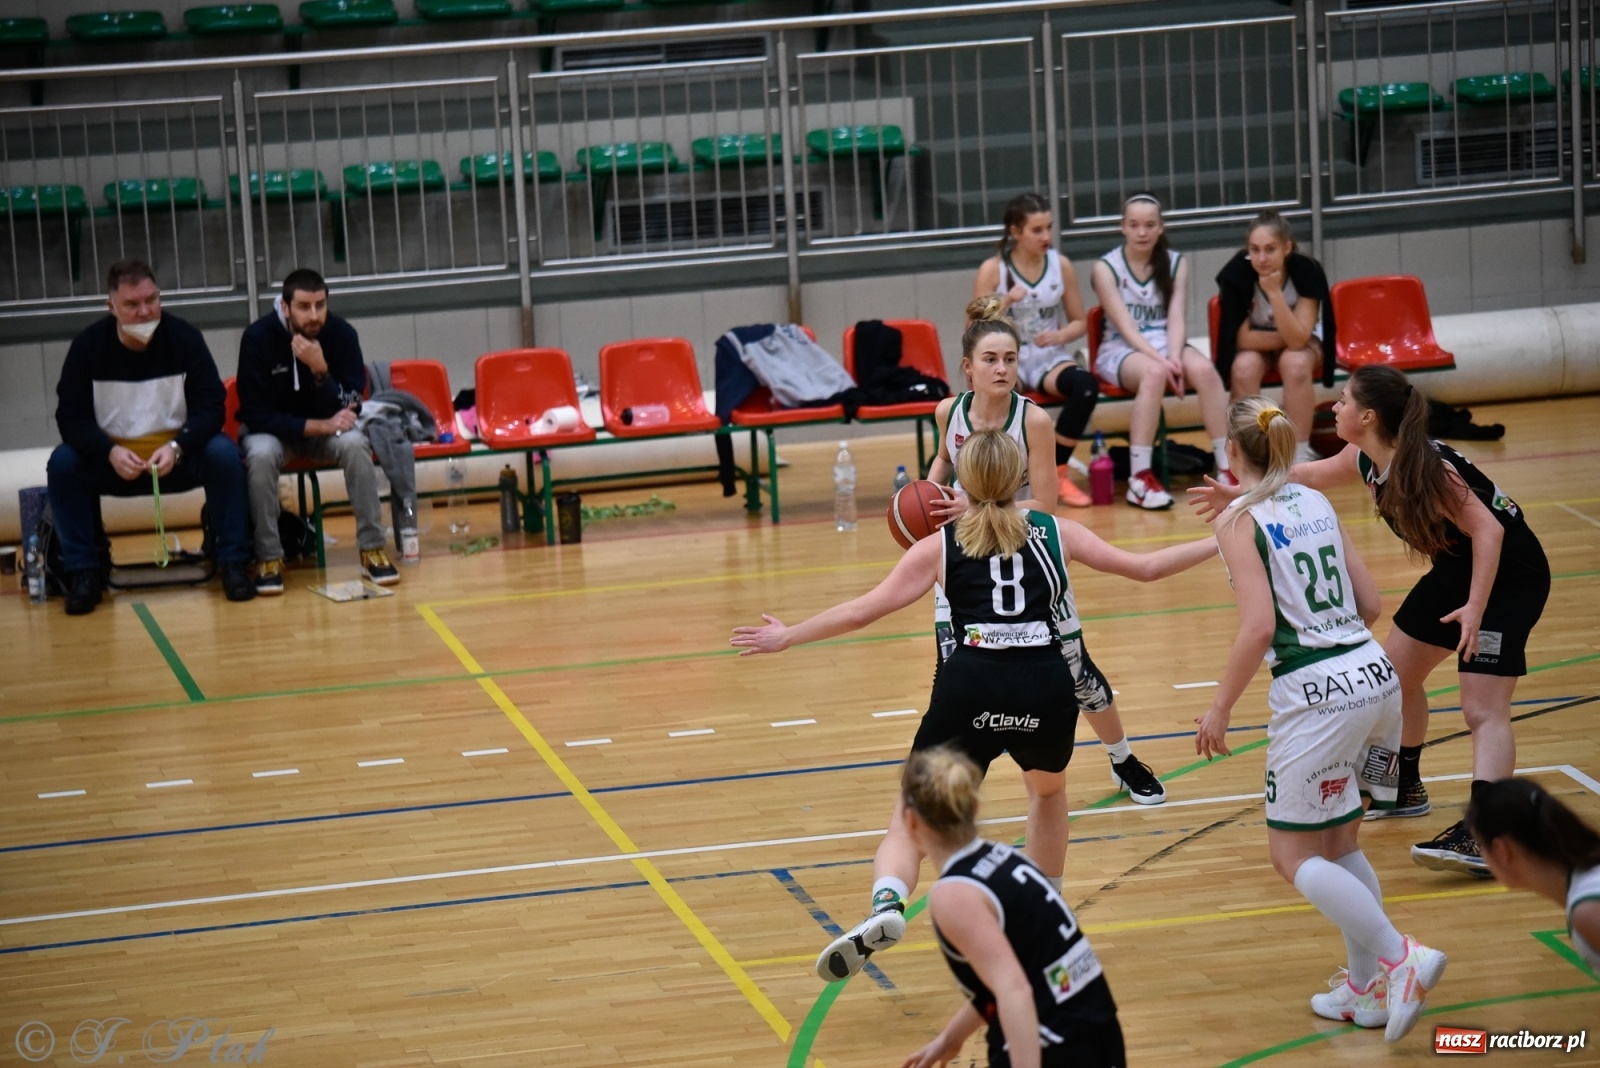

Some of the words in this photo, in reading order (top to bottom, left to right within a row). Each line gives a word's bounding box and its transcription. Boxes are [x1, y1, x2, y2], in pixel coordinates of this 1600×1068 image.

[1265, 516, 1335, 550] KOMPLIDO
[989, 552, 1026, 617] 8
[1293, 544, 1344, 614] 25
[989, 713, 1040, 728] Clavis
[1362, 747, 1390, 784] GRUPA
[1265, 771, 1277, 804] 5
[1011, 863, 1078, 940] 3
